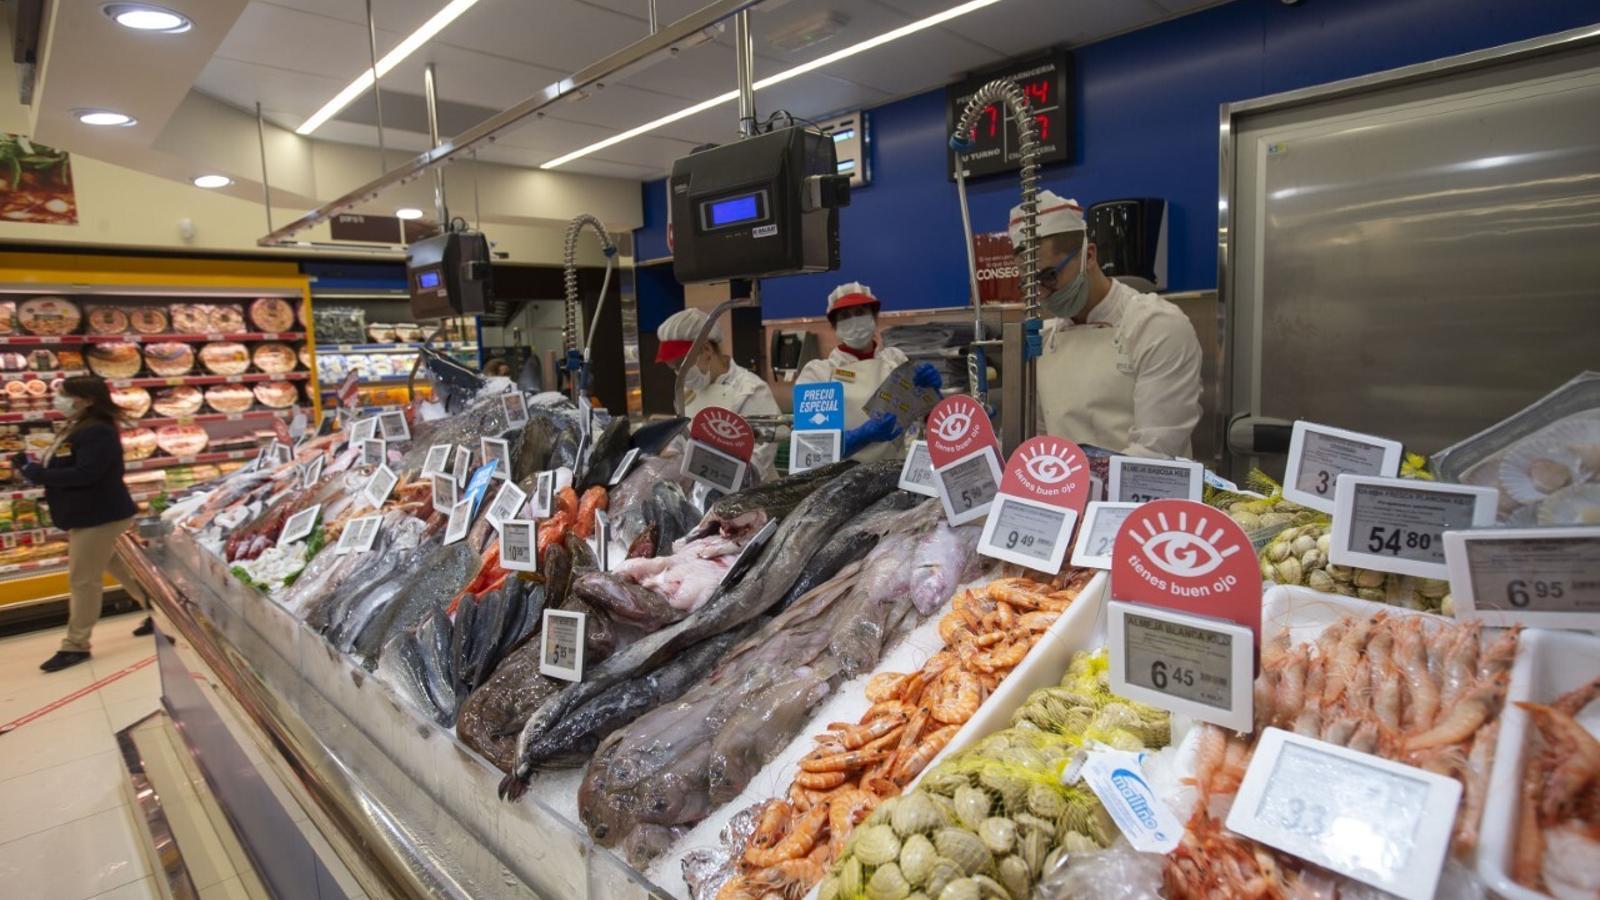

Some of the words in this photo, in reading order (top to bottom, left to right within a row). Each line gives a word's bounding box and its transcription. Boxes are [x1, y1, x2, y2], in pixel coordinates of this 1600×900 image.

[970, 147, 1001, 161] TURNO
[976, 266, 1019, 281] CONSEG
[803, 388, 836, 400] PRECIO
[799, 400, 839, 413] ESPECIAL
[1014, 468, 1035, 492] tienes
[1036, 486, 1060, 497] buen
[1061, 481, 1077, 494] ojo
[1128, 554, 1167, 591] tienes
[1171, 581, 1210, 598] buen
[1213, 574, 1238, 593] ojo
[1127, 617, 1165, 633] ALMEJA
[1166, 624, 1204, 641] BLANCA
